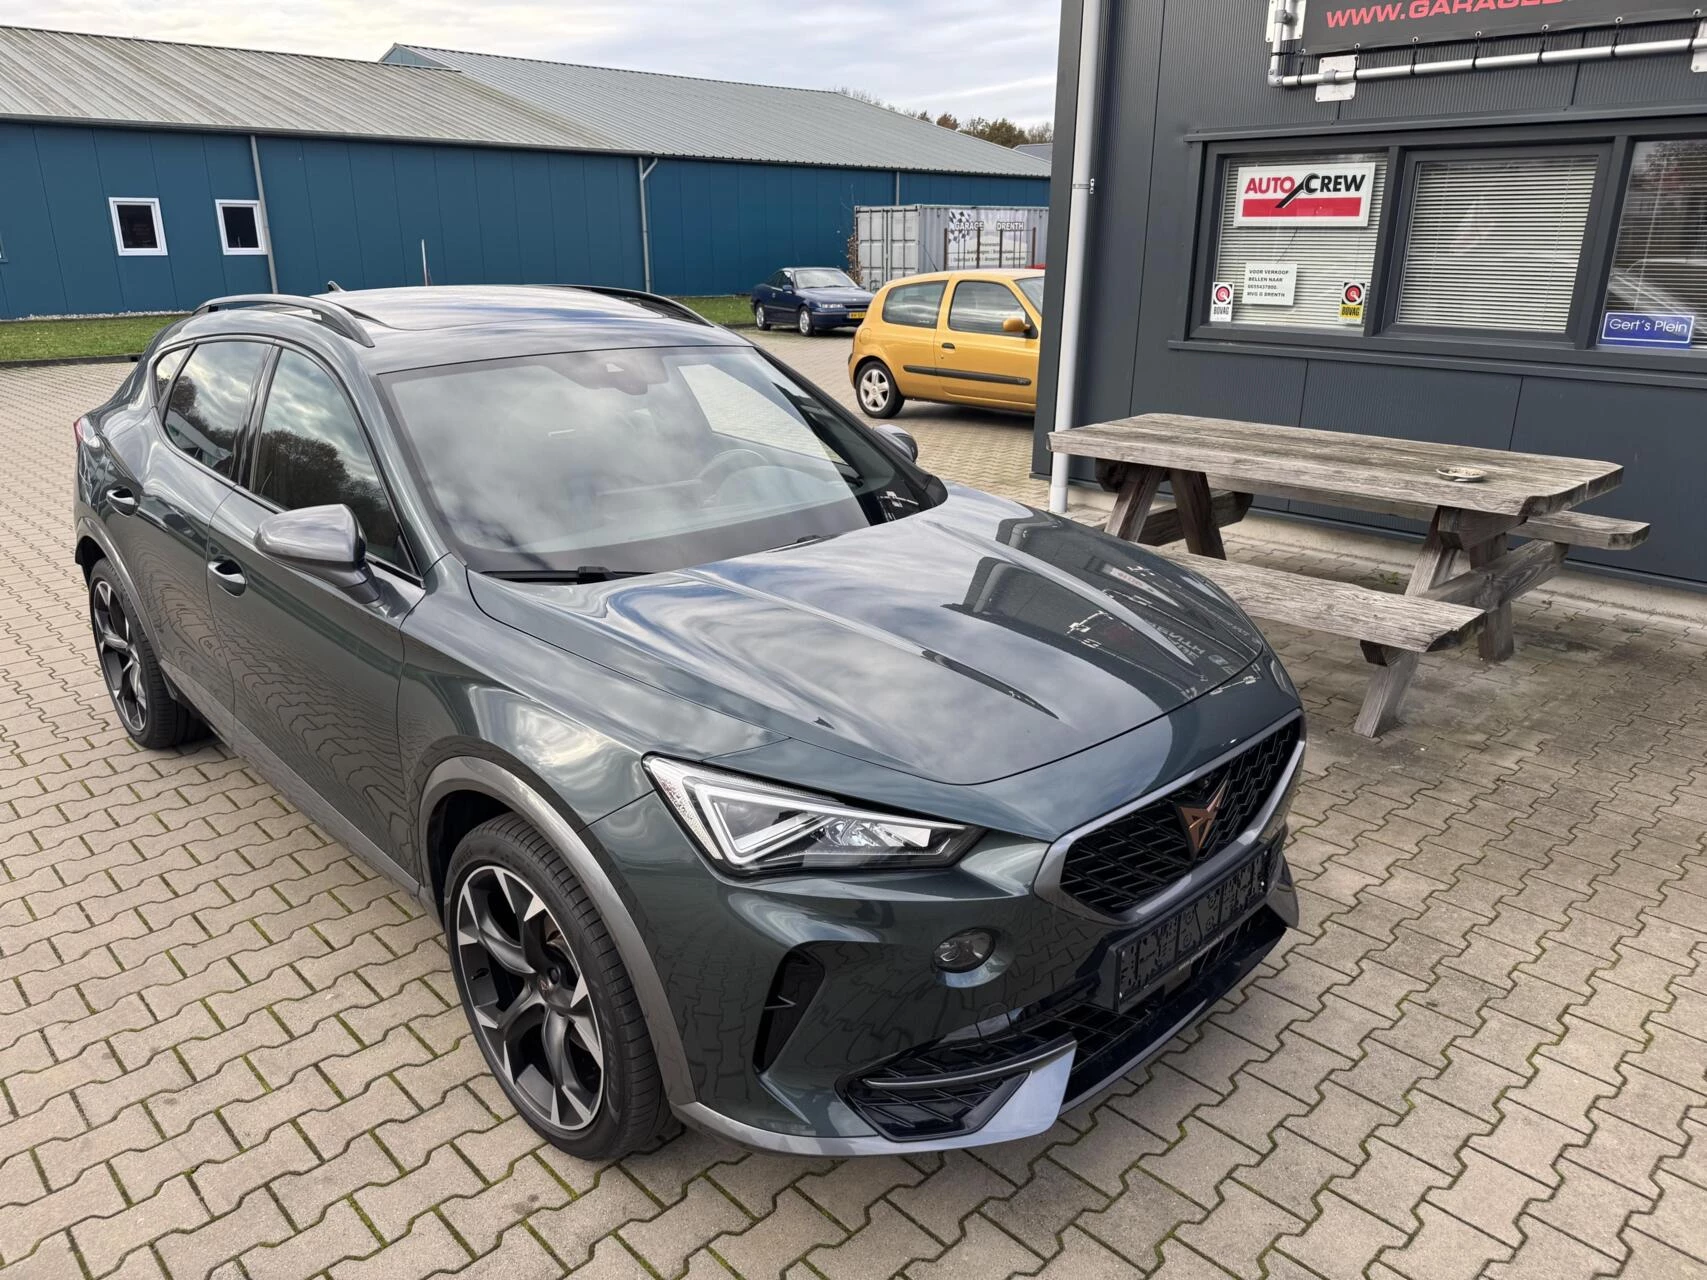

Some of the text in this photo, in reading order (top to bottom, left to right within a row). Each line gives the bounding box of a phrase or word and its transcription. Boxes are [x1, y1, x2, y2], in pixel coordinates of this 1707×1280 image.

[1245, 172, 1366, 195] AUTO CREW
[996, 221, 1024, 231] DRENTH
[1213, 306, 1230, 315] BOVAG
[1341, 306, 1361, 317] BOVAG
[1654, 320, 1688, 333] Plein
